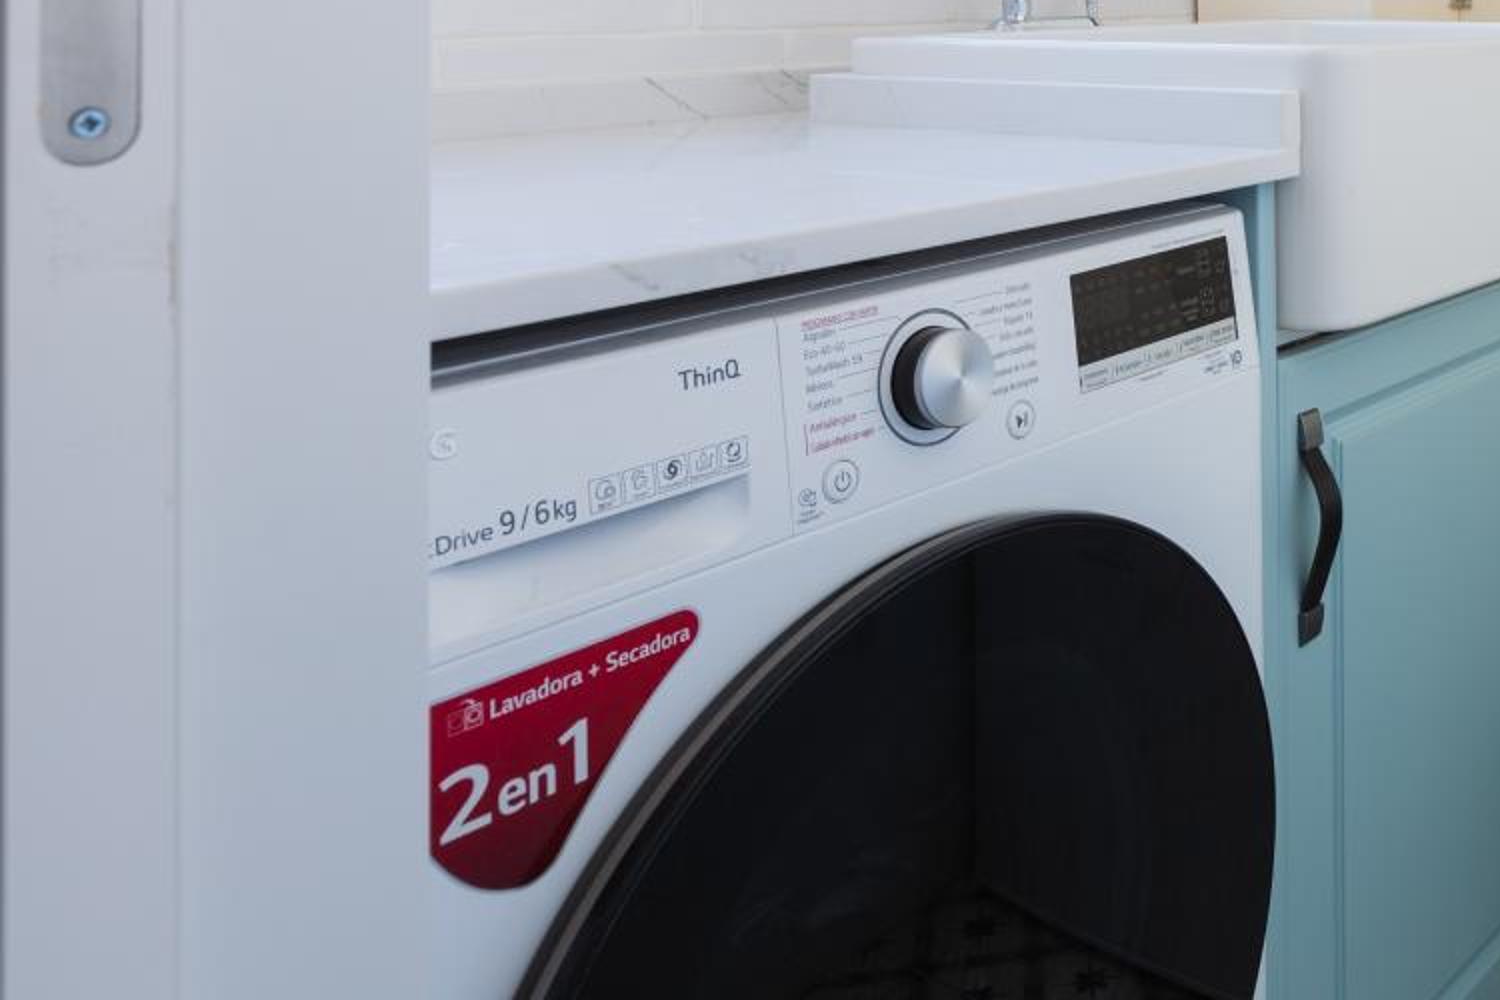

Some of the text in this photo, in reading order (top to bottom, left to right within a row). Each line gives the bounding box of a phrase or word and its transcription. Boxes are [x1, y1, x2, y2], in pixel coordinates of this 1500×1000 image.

[678, 358, 742, 391] ThinQ
[429, 526, 494, 558] Drive
[489, 626, 691, 719] Lavadora + Secadora
[438, 716, 589, 847] 2 en 1
